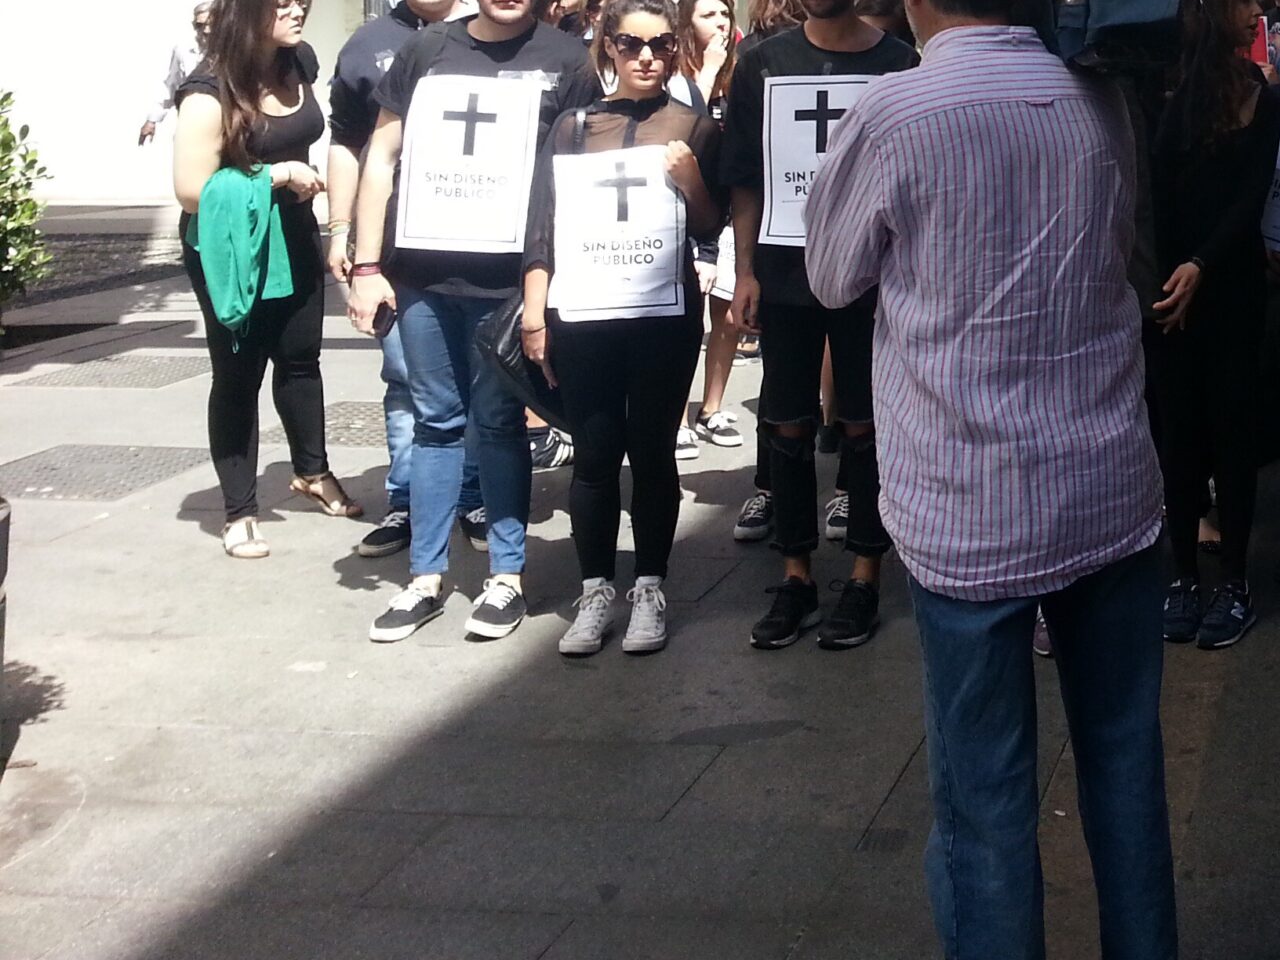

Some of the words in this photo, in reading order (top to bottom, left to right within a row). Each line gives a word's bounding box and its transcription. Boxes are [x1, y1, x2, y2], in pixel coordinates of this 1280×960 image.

[425, 171, 449, 182] SIN
[784, 171, 806, 183] SIN
[582, 241, 606, 252] SIN
[611, 236, 663, 251] DISEÑO
